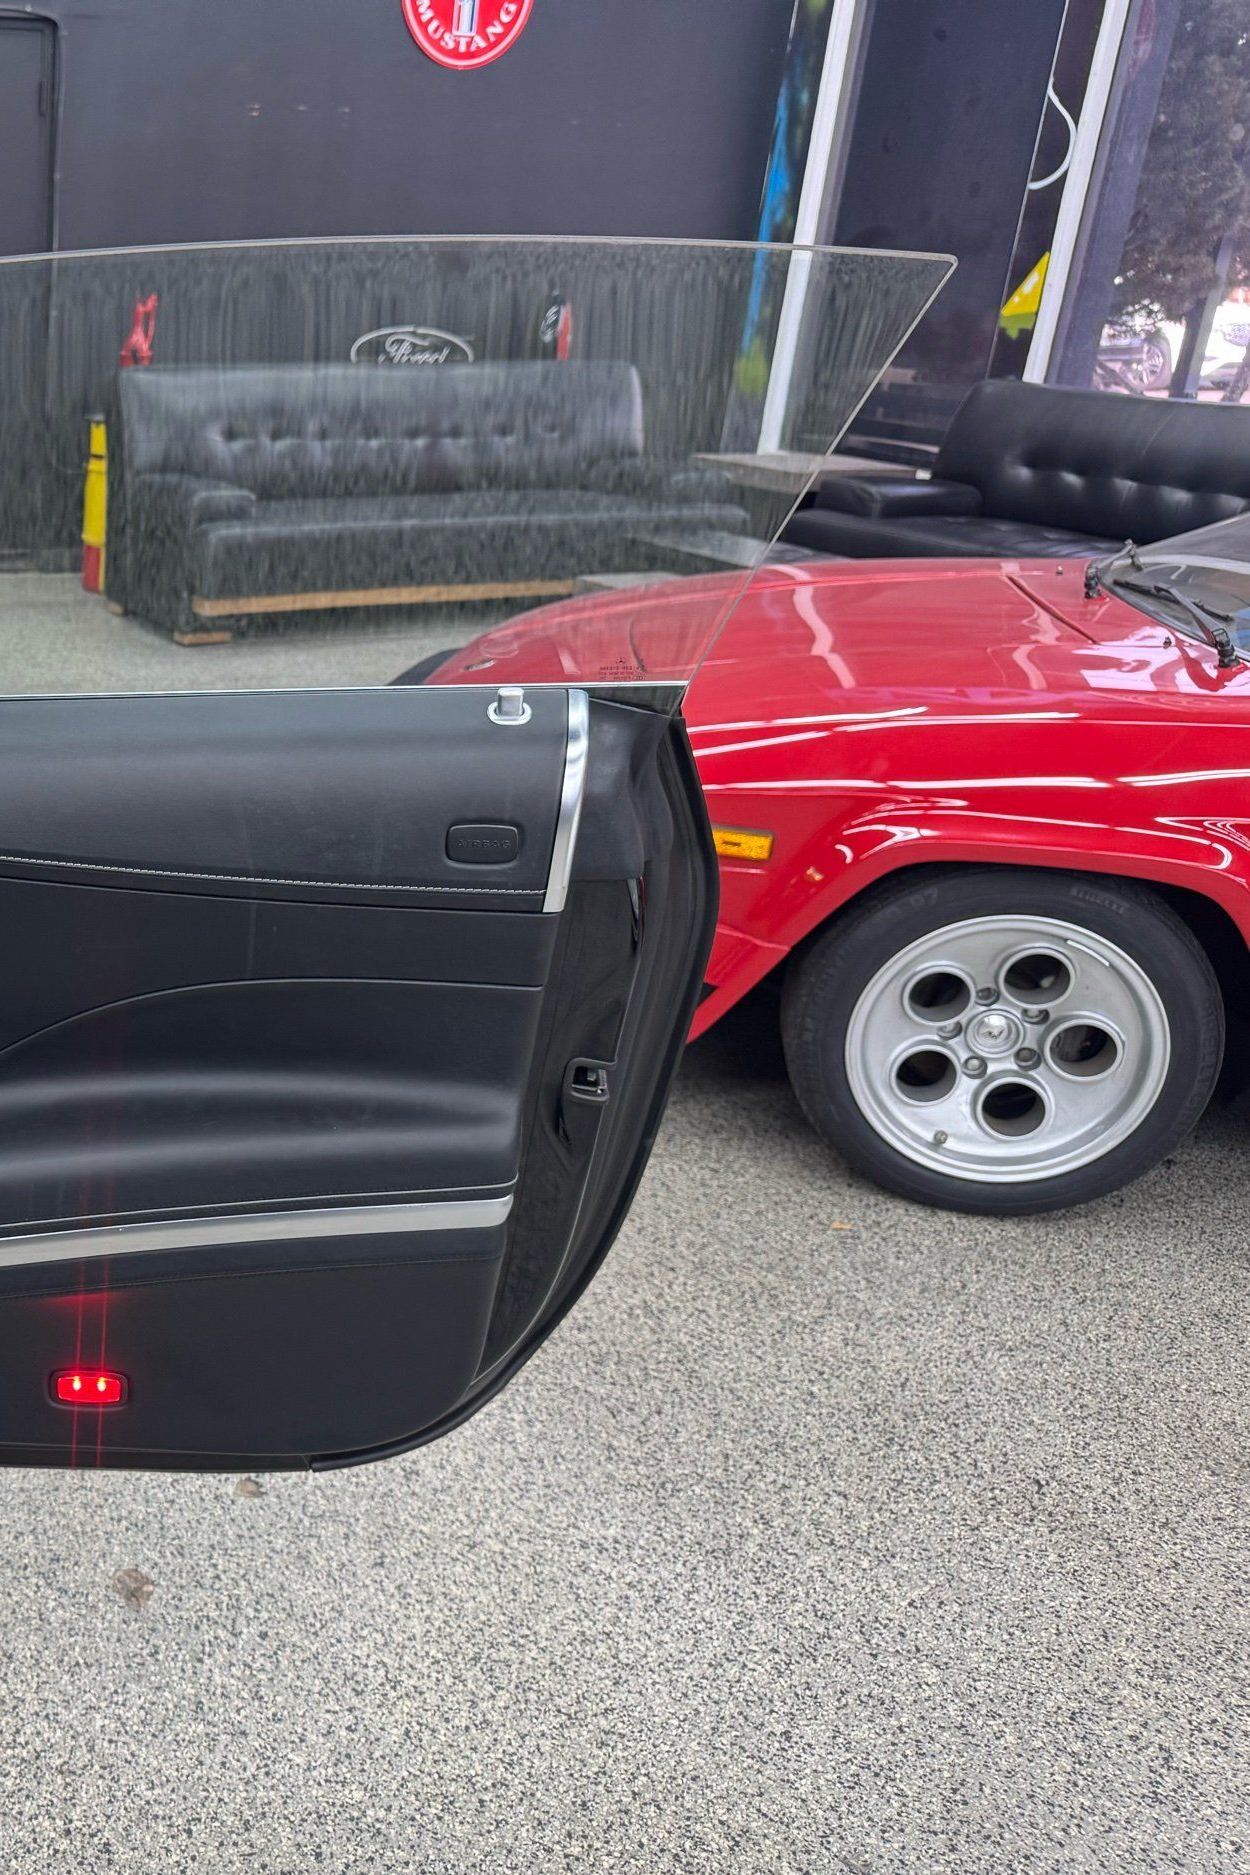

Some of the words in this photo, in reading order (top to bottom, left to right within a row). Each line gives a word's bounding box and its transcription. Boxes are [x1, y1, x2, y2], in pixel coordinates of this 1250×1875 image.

[416, 0, 518, 53] MUSTANG
[379, 334, 451, 364] Ford
[457, 839, 510, 848] AIRBAG
